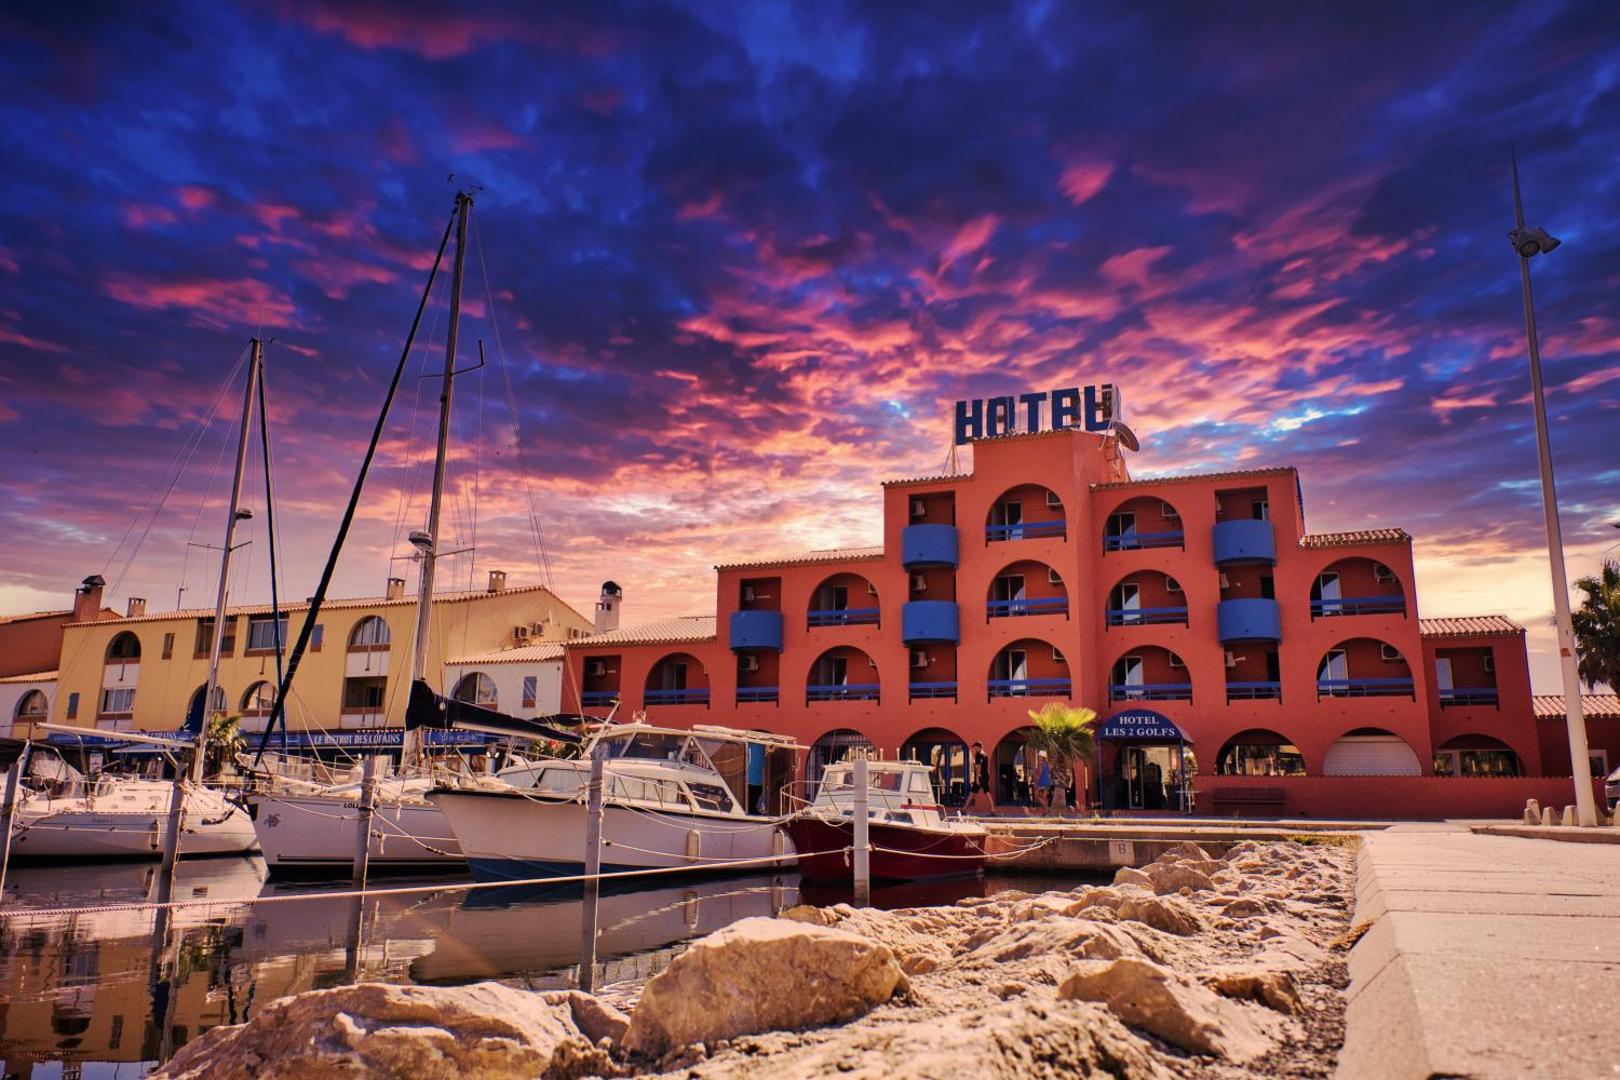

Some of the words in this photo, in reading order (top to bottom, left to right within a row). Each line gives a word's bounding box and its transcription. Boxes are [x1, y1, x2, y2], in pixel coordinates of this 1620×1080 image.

[956, 385, 1112, 445] HOTEL
[1119, 716, 1160, 725] HOTEL
[1105, 728, 1126, 736] LES
[1128, 728, 1134, 736] 2
[1136, 727, 1175, 736] GOLFS
[314, 735, 323, 745] LE
[354, 734, 367, 744] DES
